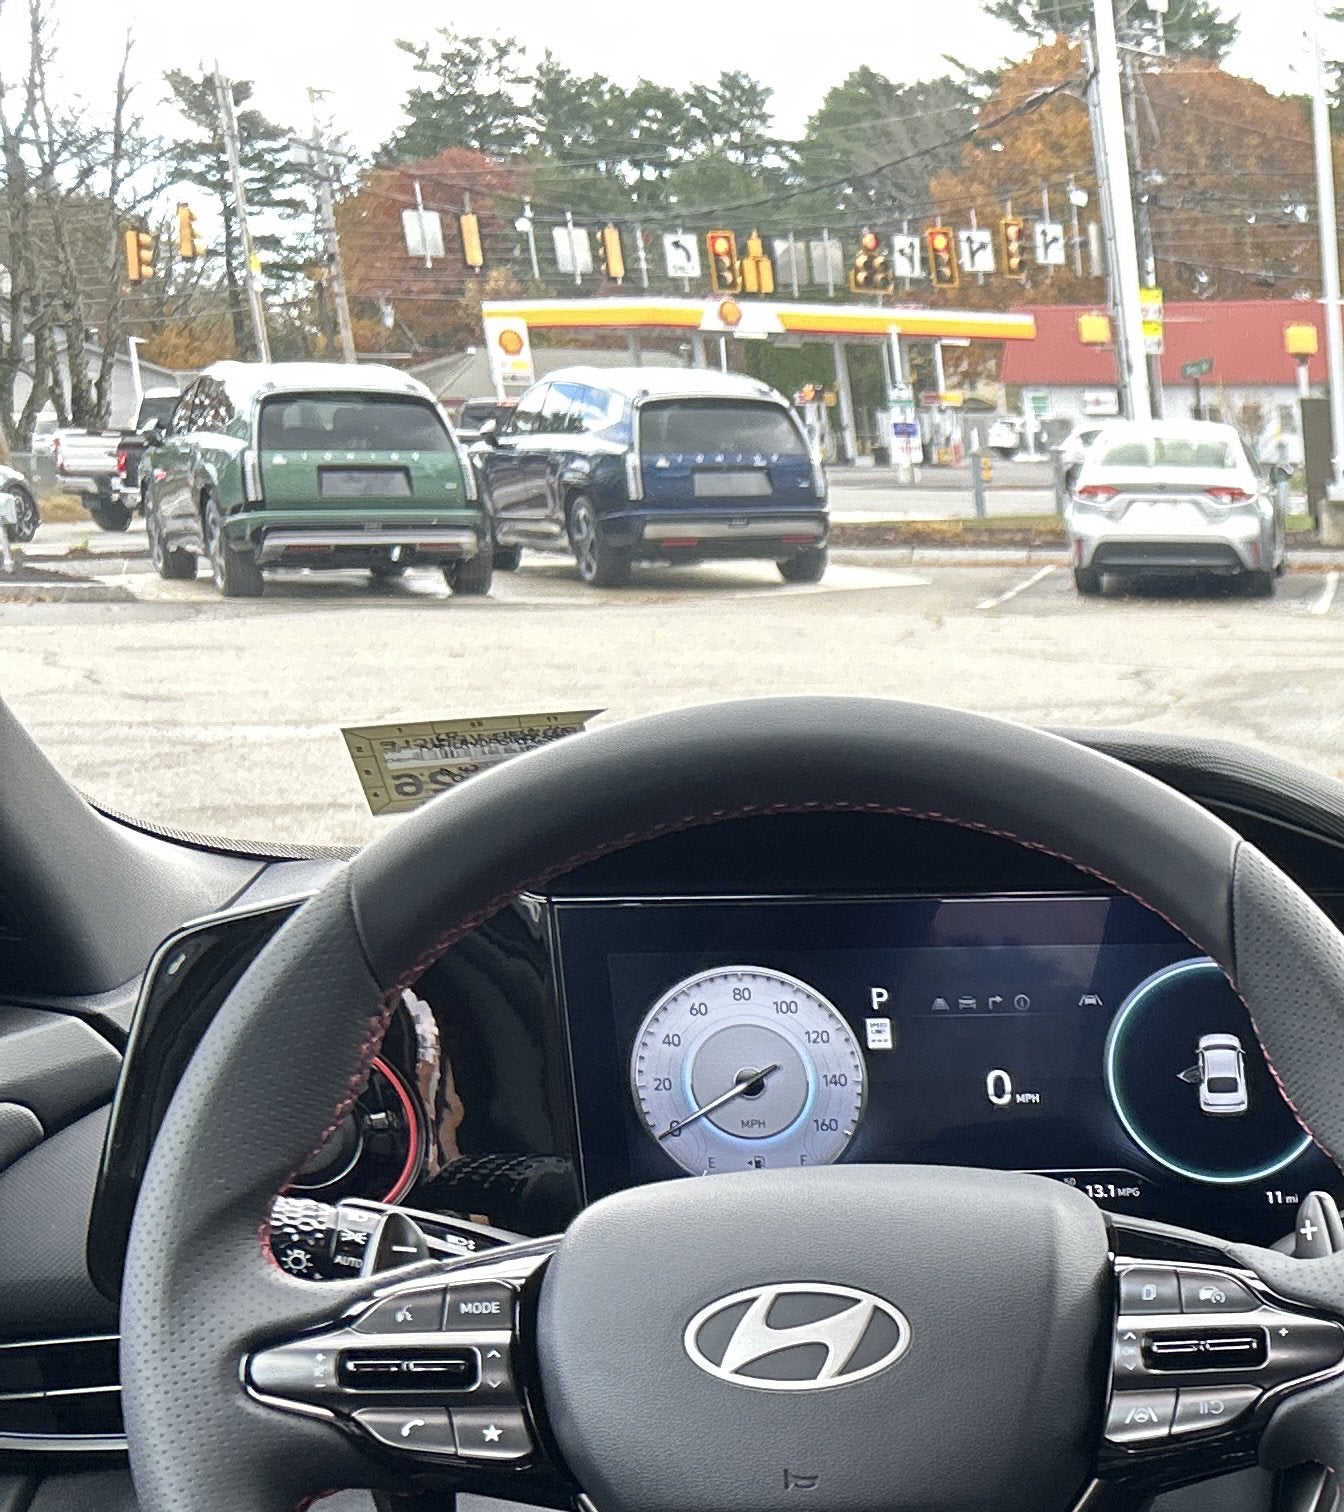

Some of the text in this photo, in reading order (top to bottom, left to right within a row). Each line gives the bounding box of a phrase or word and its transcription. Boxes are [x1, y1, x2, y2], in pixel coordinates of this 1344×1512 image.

[733, 987, 752, 1002] 80
[870, 987, 889, 1011] P
[689, 1002, 709, 1017] 60
[772, 1000, 799, 1016] 100
[662, 1033, 682, 1048] 40
[805, 1030, 831, 1045] 120
[653, 1077, 674, 1092] 20
[823, 1073, 848, 1088] 140
[986, 1068, 1041, 1106] 0 MPH
[740, 1118, 767, 1130] MPH
[813, 1118, 839, 1133] 160
[707, 1155, 717, 1170] E
[800, 1154, 808, 1167] F
[1265, 1191, 1299, 1205] 11 mi
[334, 1254, 364, 1269] AUTO
[459, 1302, 501, 1315] MODE
